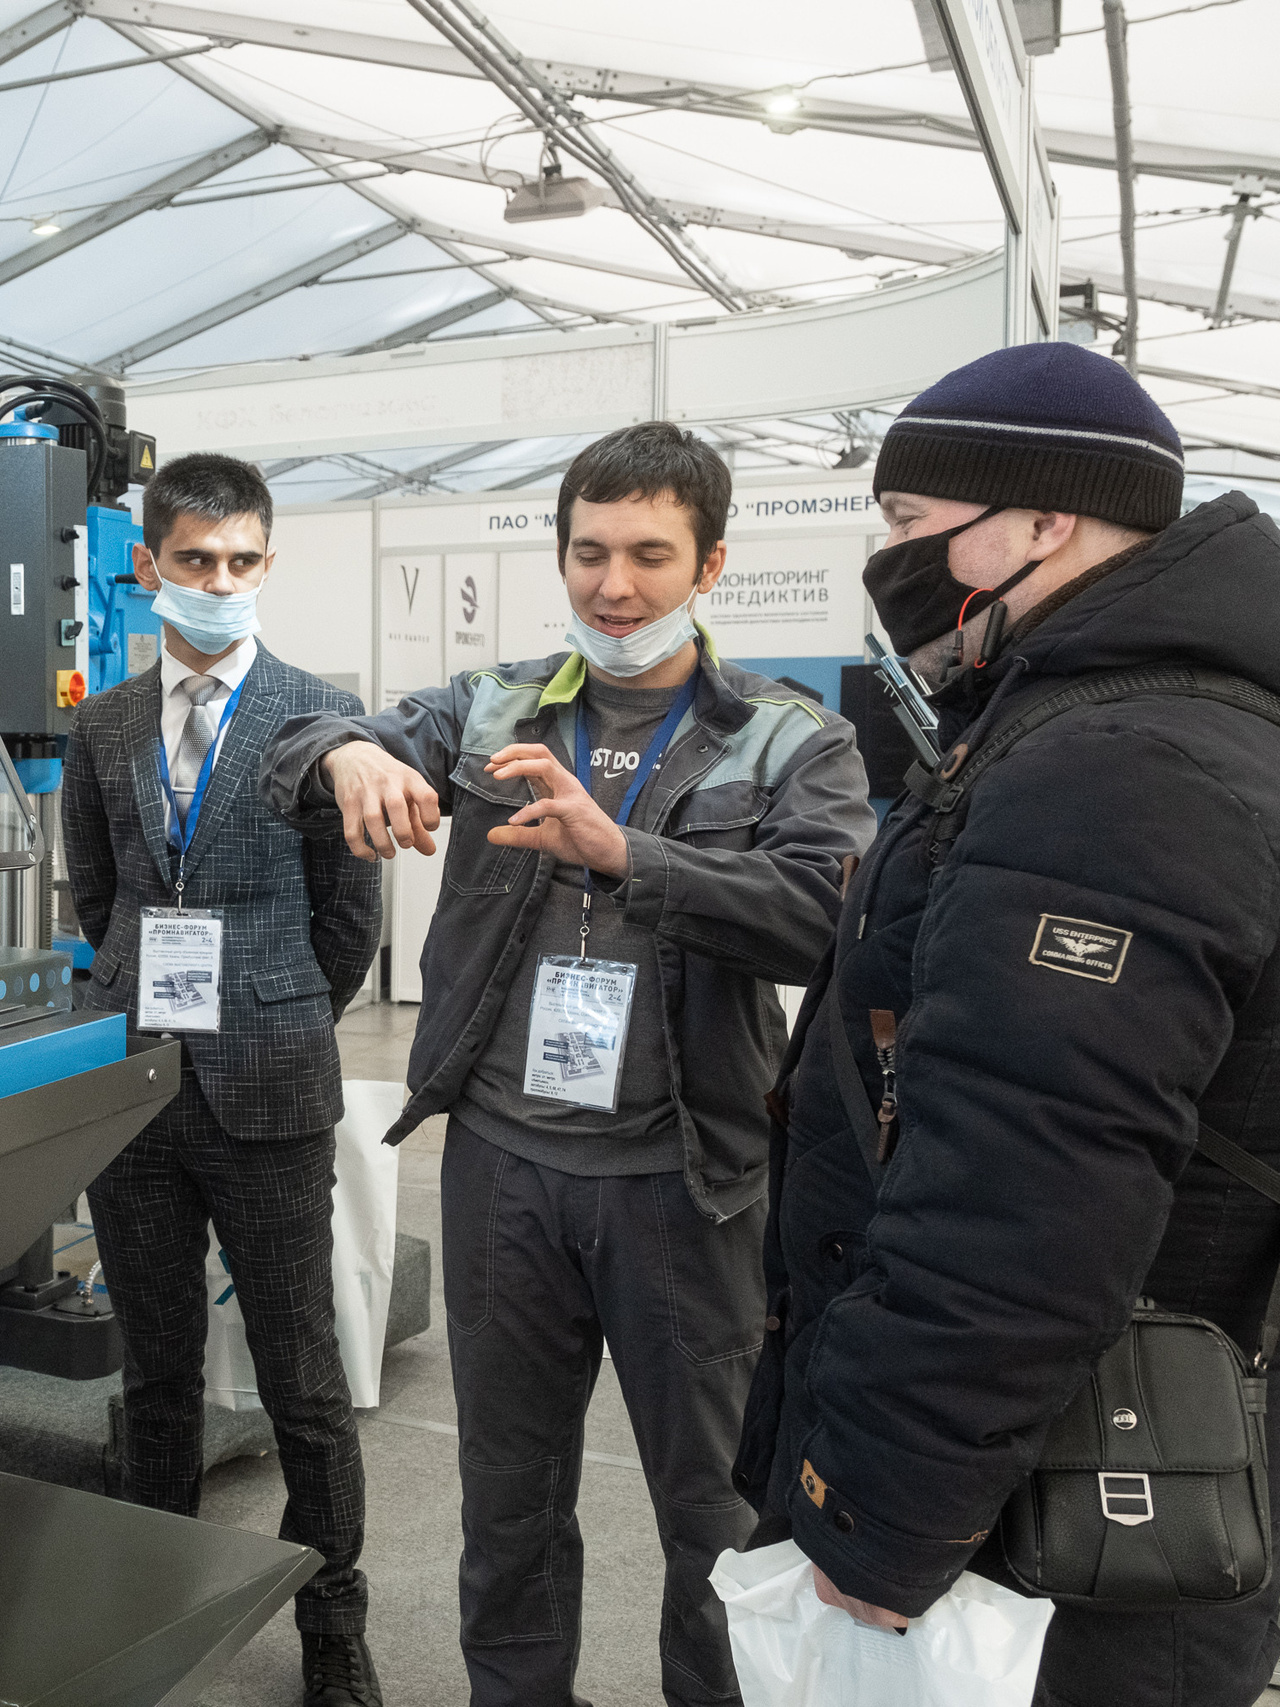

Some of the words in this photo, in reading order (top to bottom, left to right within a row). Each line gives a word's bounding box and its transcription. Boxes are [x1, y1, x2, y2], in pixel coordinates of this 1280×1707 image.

[489, 515, 528, 530] ПАО
[711, 587, 829, 607] ПРЕДИКТИВ
[613, 751, 640, 770] DO
[154, 923, 208, 931] БИЗНЕС-ФОРУМ
